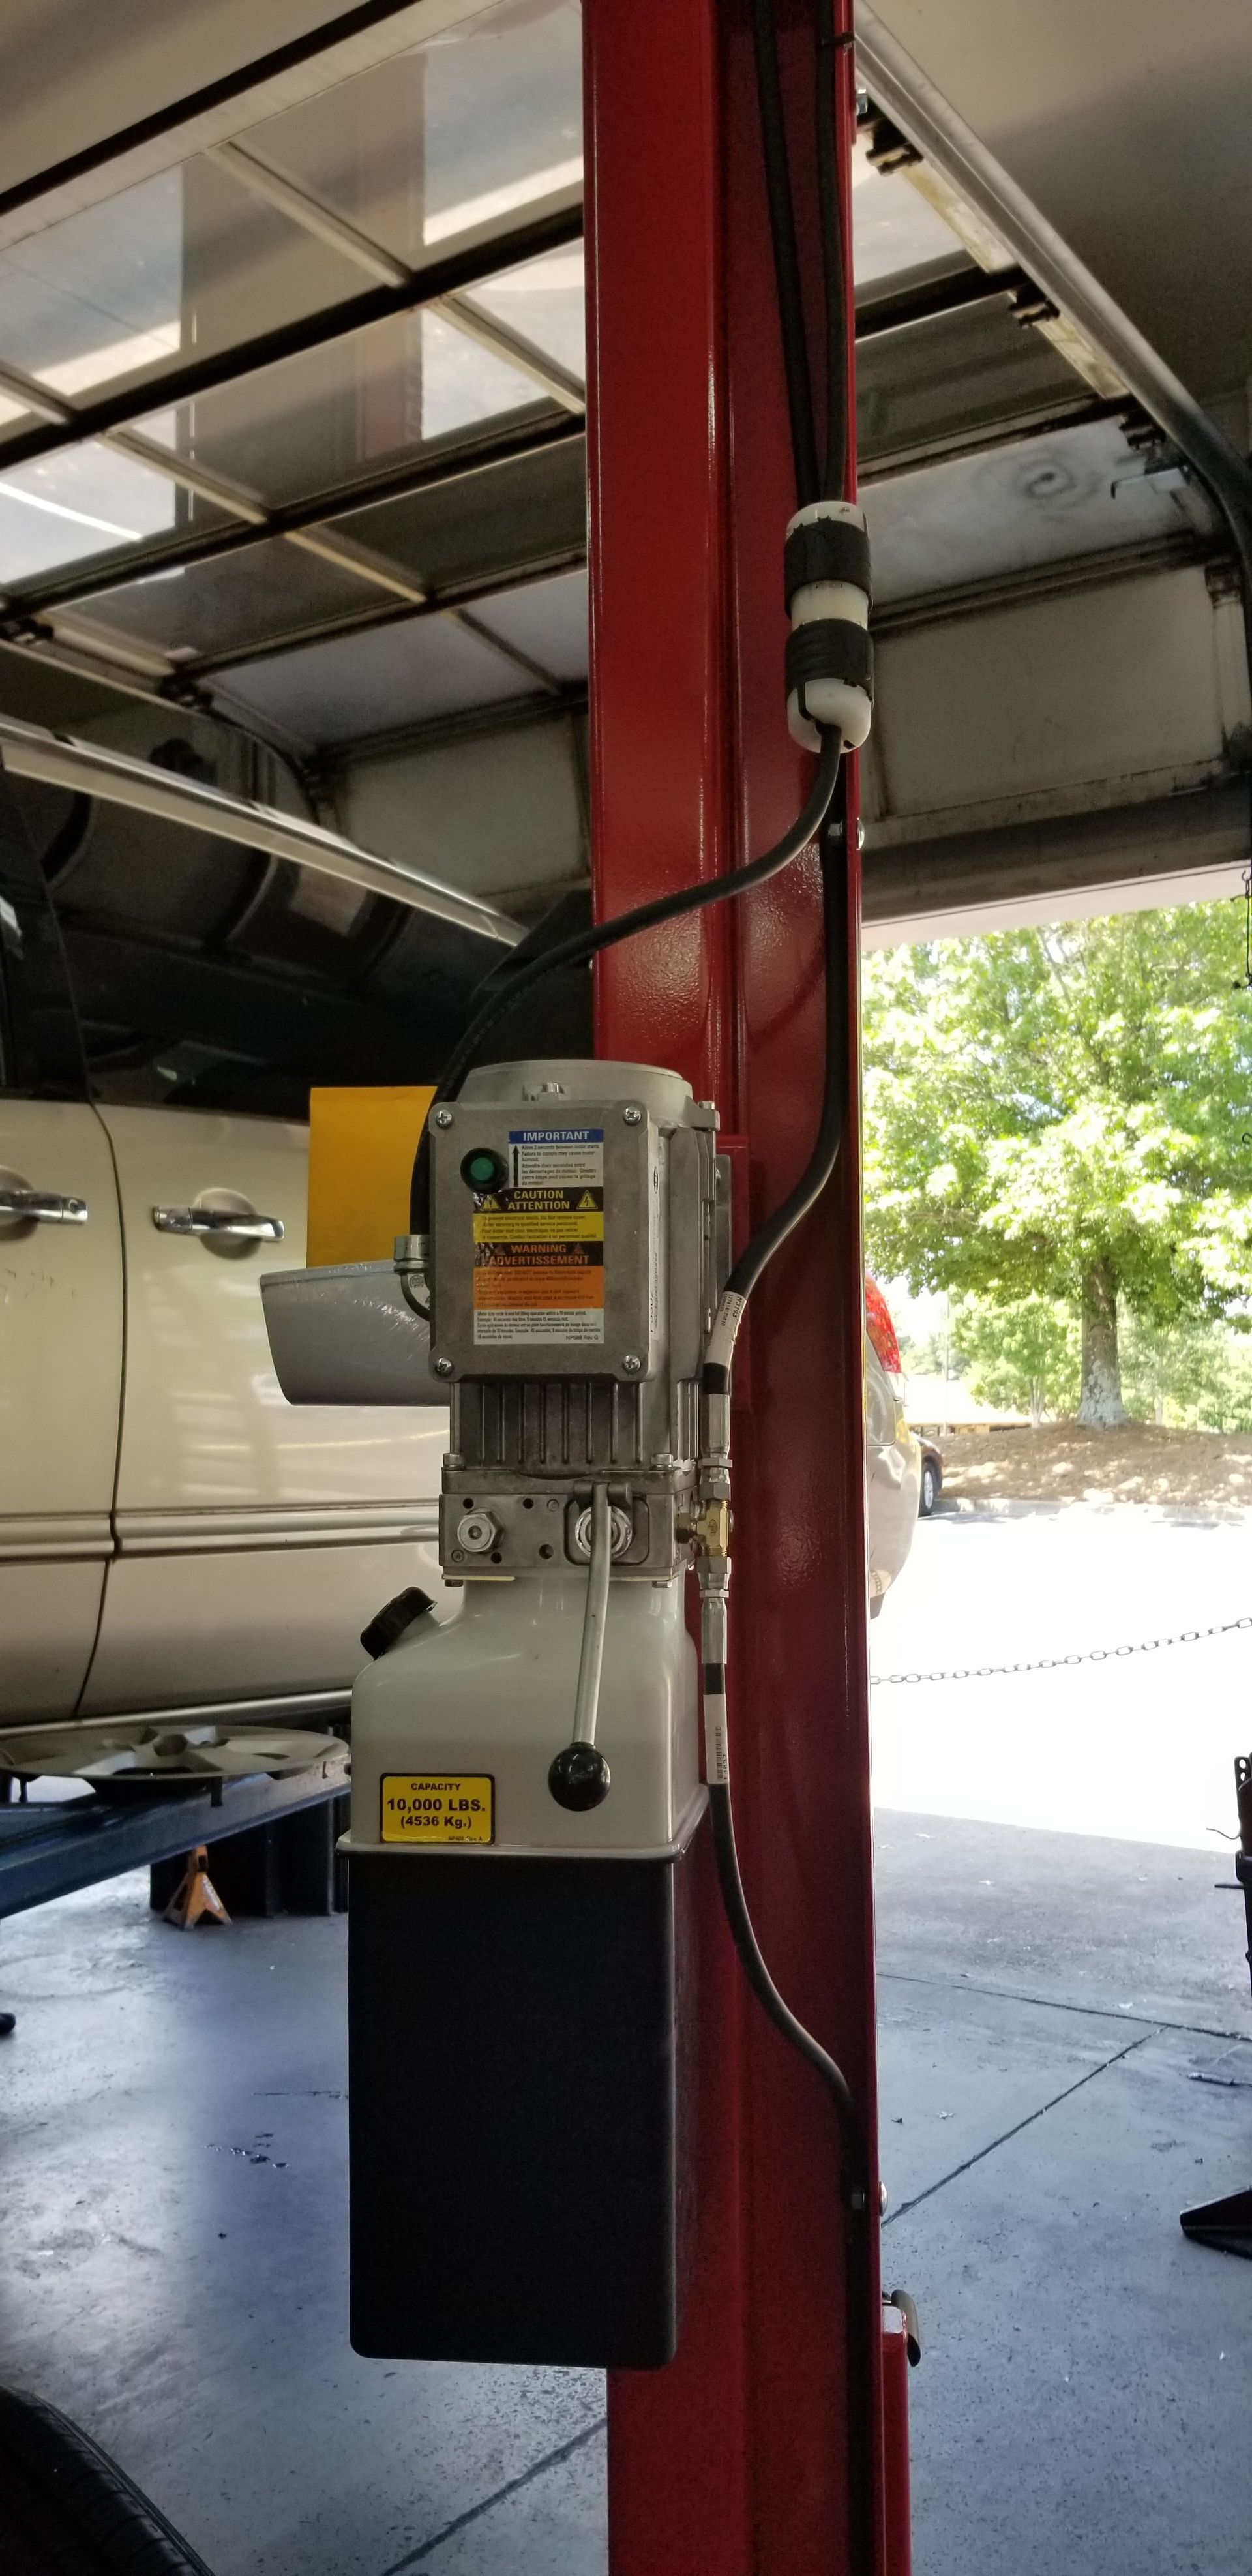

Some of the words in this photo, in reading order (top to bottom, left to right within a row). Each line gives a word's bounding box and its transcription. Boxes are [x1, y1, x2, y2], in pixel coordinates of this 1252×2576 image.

[524, 1131, 589, 1141] IMPORTANT
[514, 1190, 563, 1199] CAUTION
[507, 1201, 570, 1210] ATTENTION
[511, 1244, 567, 1253] WARNING
[490, 1255, 589, 1265] ADVERTISSEMENT
[387, 1799, 442, 1814] 10,000
[449, 1799, 486, 1811] LBS.
[400, 1816, 439, 1829] (4536
[444, 1816, 472, 1829] Kg.)
